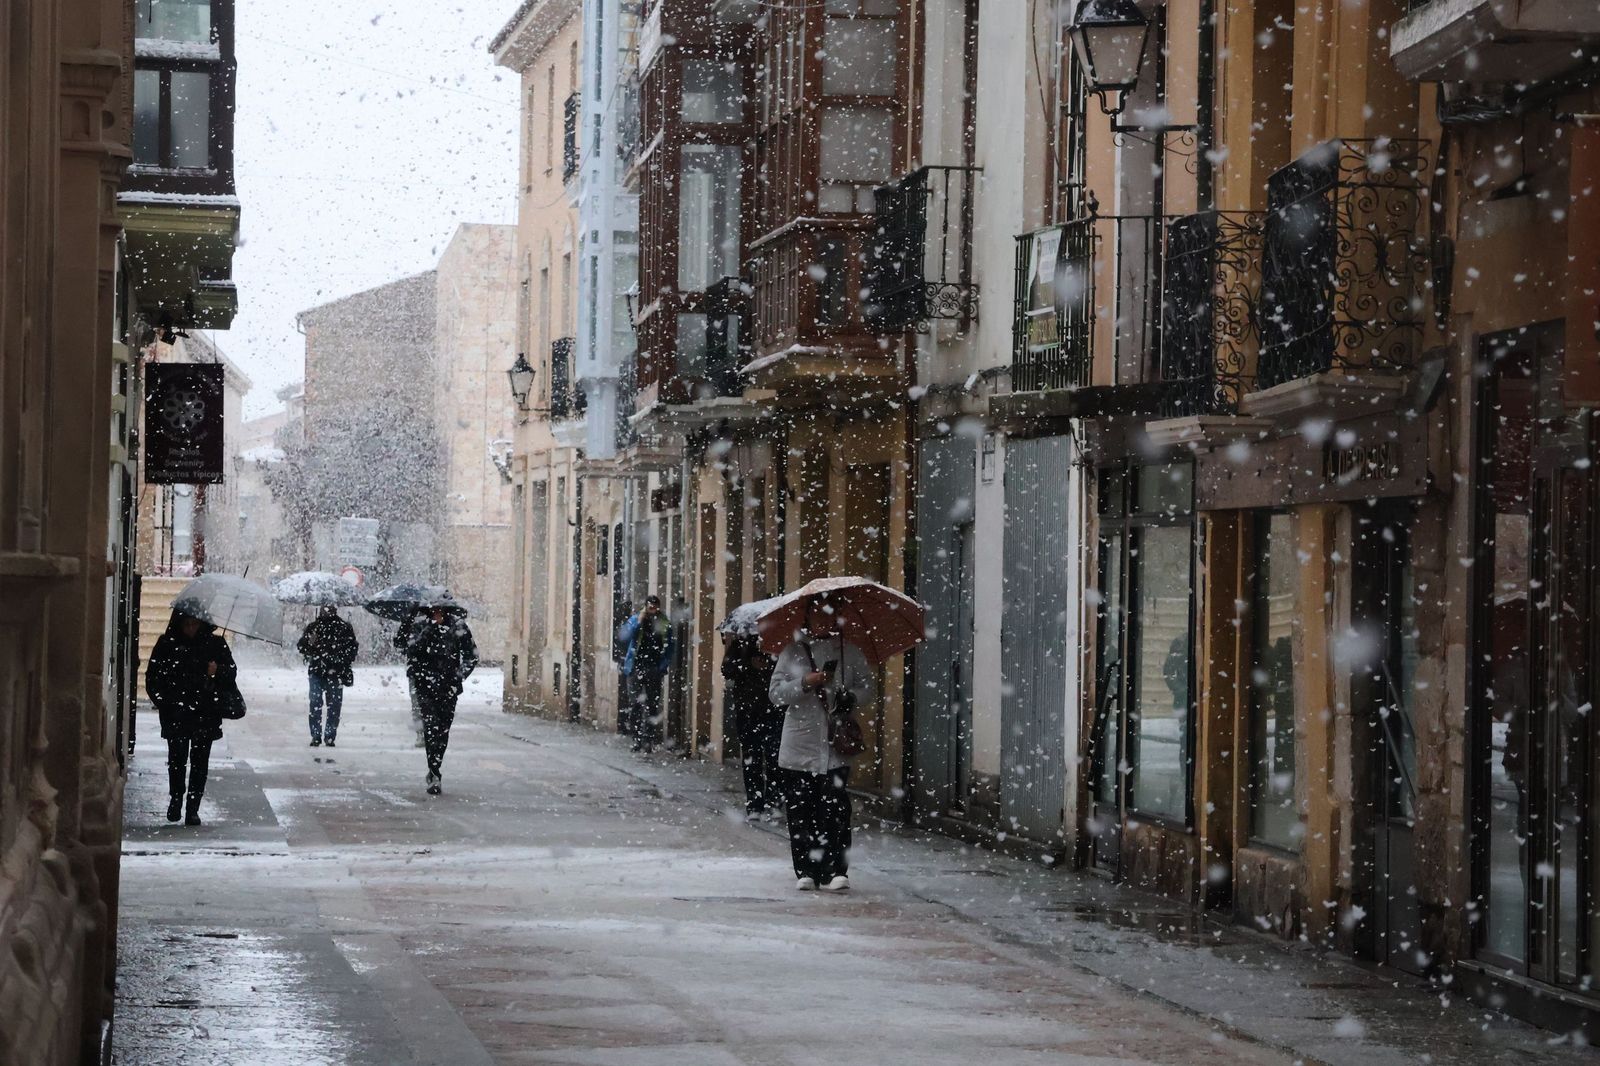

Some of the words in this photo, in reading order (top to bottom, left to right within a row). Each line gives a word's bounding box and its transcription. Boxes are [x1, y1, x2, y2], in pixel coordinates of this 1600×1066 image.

[168, 447, 201, 457] Regalos
[164, 458, 205, 467] Souvenirs
[149, 469, 190, 478] Productos
